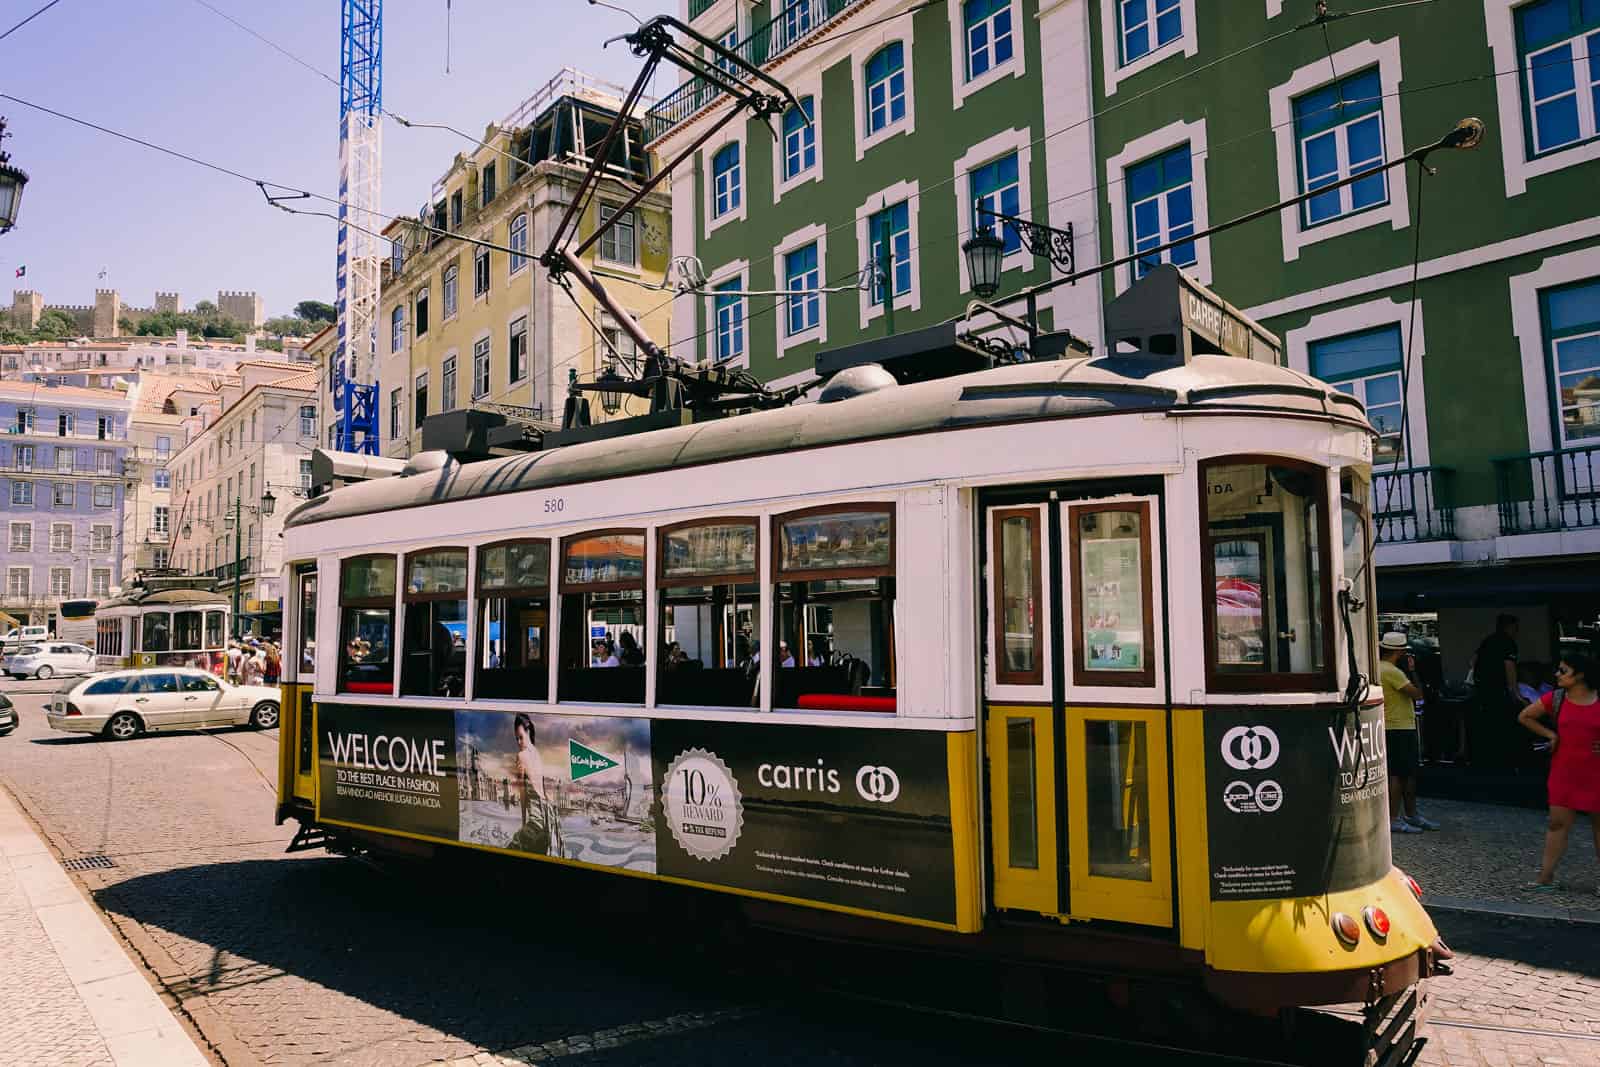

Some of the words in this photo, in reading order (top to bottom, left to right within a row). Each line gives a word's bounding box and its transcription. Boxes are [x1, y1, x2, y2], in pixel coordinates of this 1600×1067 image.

[544, 498, 564, 513] 580
[327, 731, 447, 777] WELCOME
[336, 769, 347, 782] TO
[347, 770, 360, 783] THE
[360, 772, 375, 786] BEST
[376, 774, 397, 788] PLACE
[397, 777, 406, 789] IN
[406, 777, 440, 793] FASHION
[757, 758, 841, 793] carris
[1341, 771, 1353, 787] TO
[682, 805, 724, 822] REWARD
